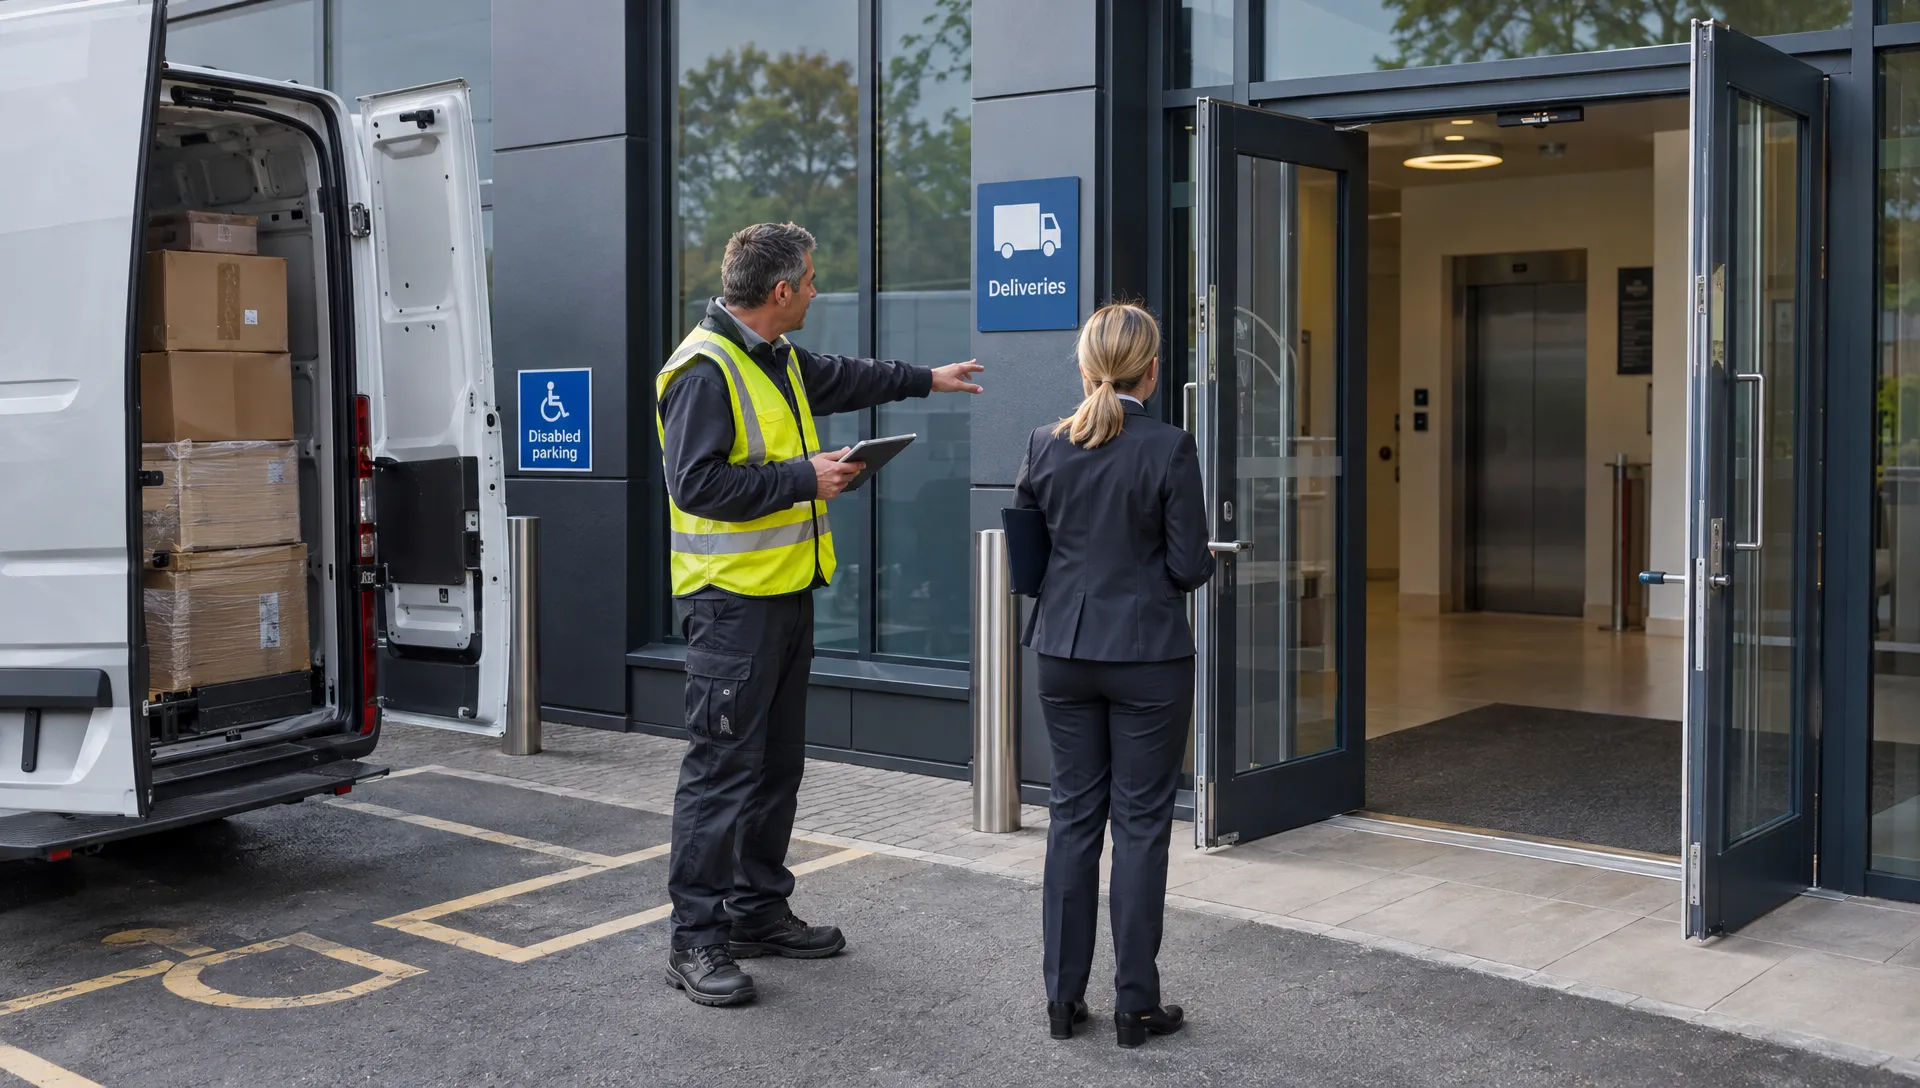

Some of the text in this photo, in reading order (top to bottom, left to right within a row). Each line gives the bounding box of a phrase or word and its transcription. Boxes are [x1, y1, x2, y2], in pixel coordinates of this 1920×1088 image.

[989, 277, 1066, 297] Deliveries
[528, 429, 581, 443] Disabled
[532, 446, 578, 462] parking
